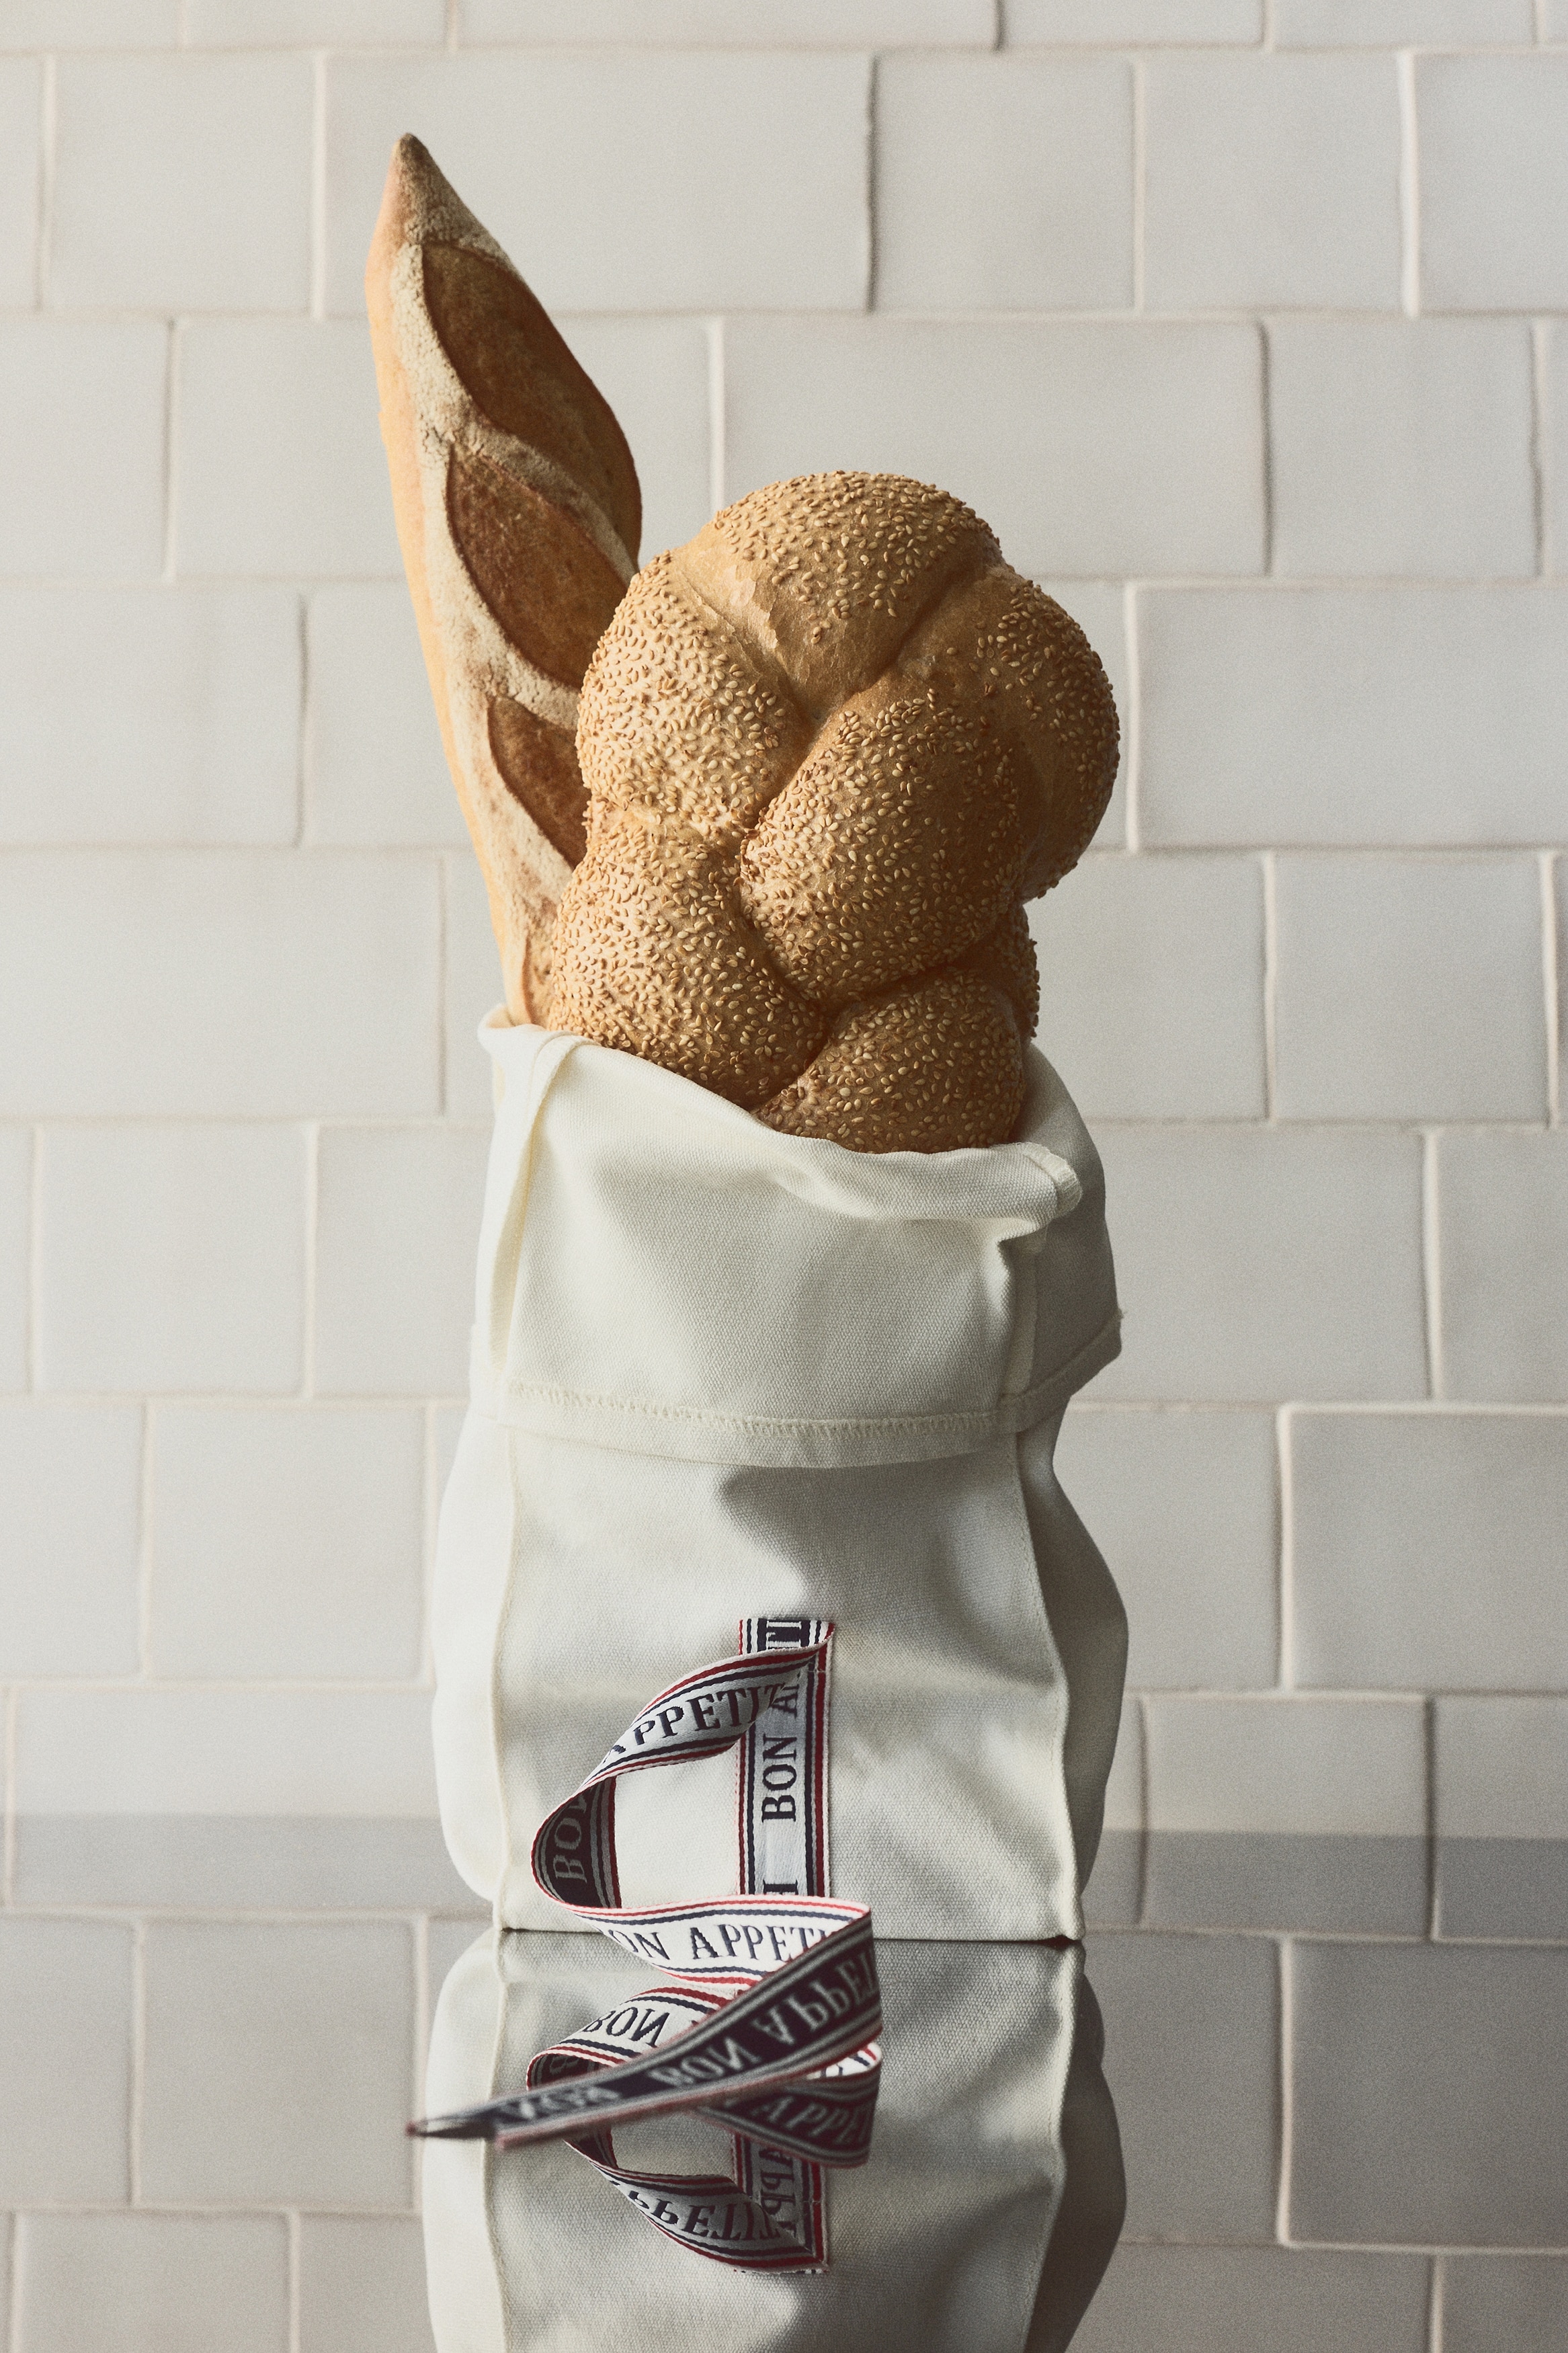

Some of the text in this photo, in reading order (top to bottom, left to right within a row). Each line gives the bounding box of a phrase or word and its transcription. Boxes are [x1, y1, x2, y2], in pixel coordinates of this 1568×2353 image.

[603, 1683, 786, 1756] PPETIT
[762, 1734, 797, 1823] BON
[600, 1923, 828, 1962] ON APPET
